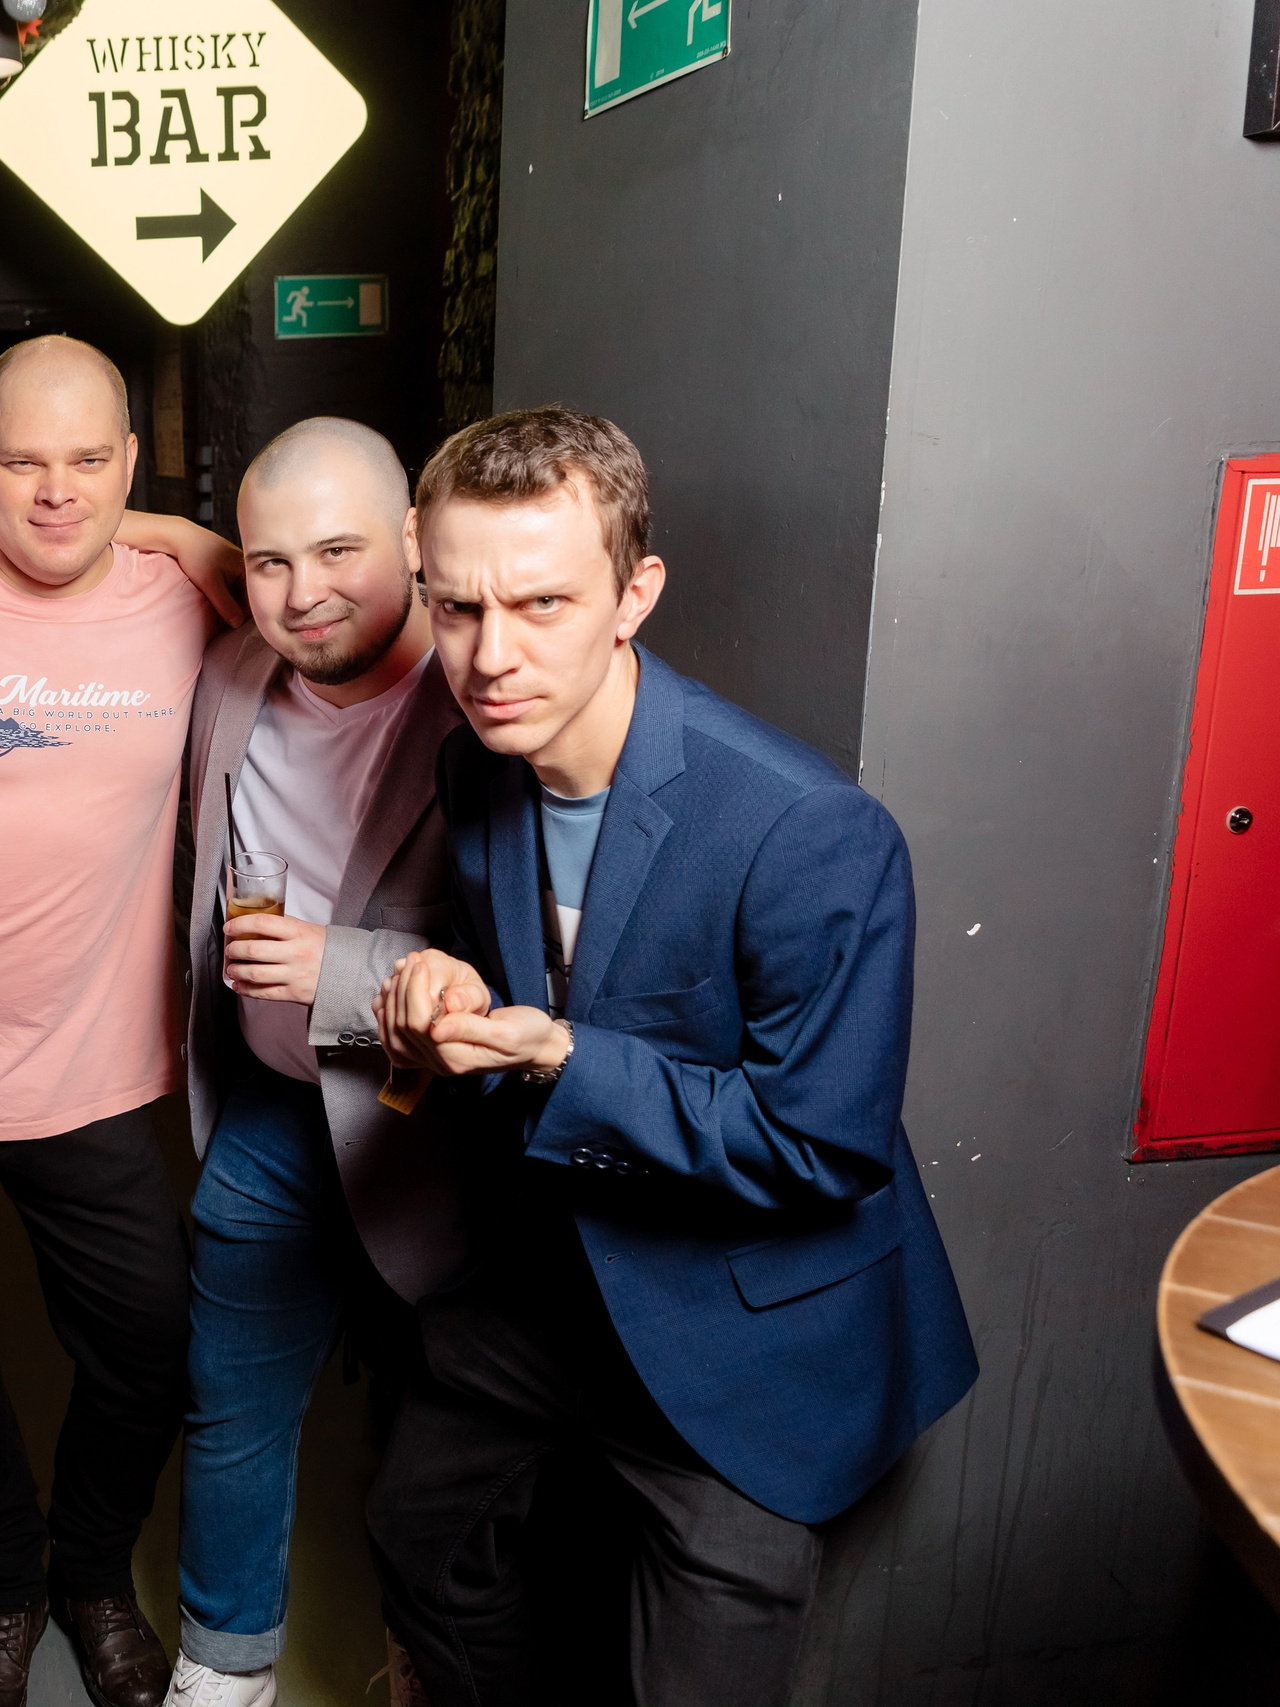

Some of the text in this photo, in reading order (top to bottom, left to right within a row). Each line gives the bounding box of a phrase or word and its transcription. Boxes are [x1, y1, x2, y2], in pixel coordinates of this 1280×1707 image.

[86, 32, 267, 74] WHISKY
[88, 85, 271, 167] BAR
[13, 708, 36, 717] BIG
[45, 710, 94, 719] WORLD
[102, 711, 129, 719] OUT
[138, 707, 176, 719] THERE.
[20, 721, 116, 733] GO EXPLORE.
